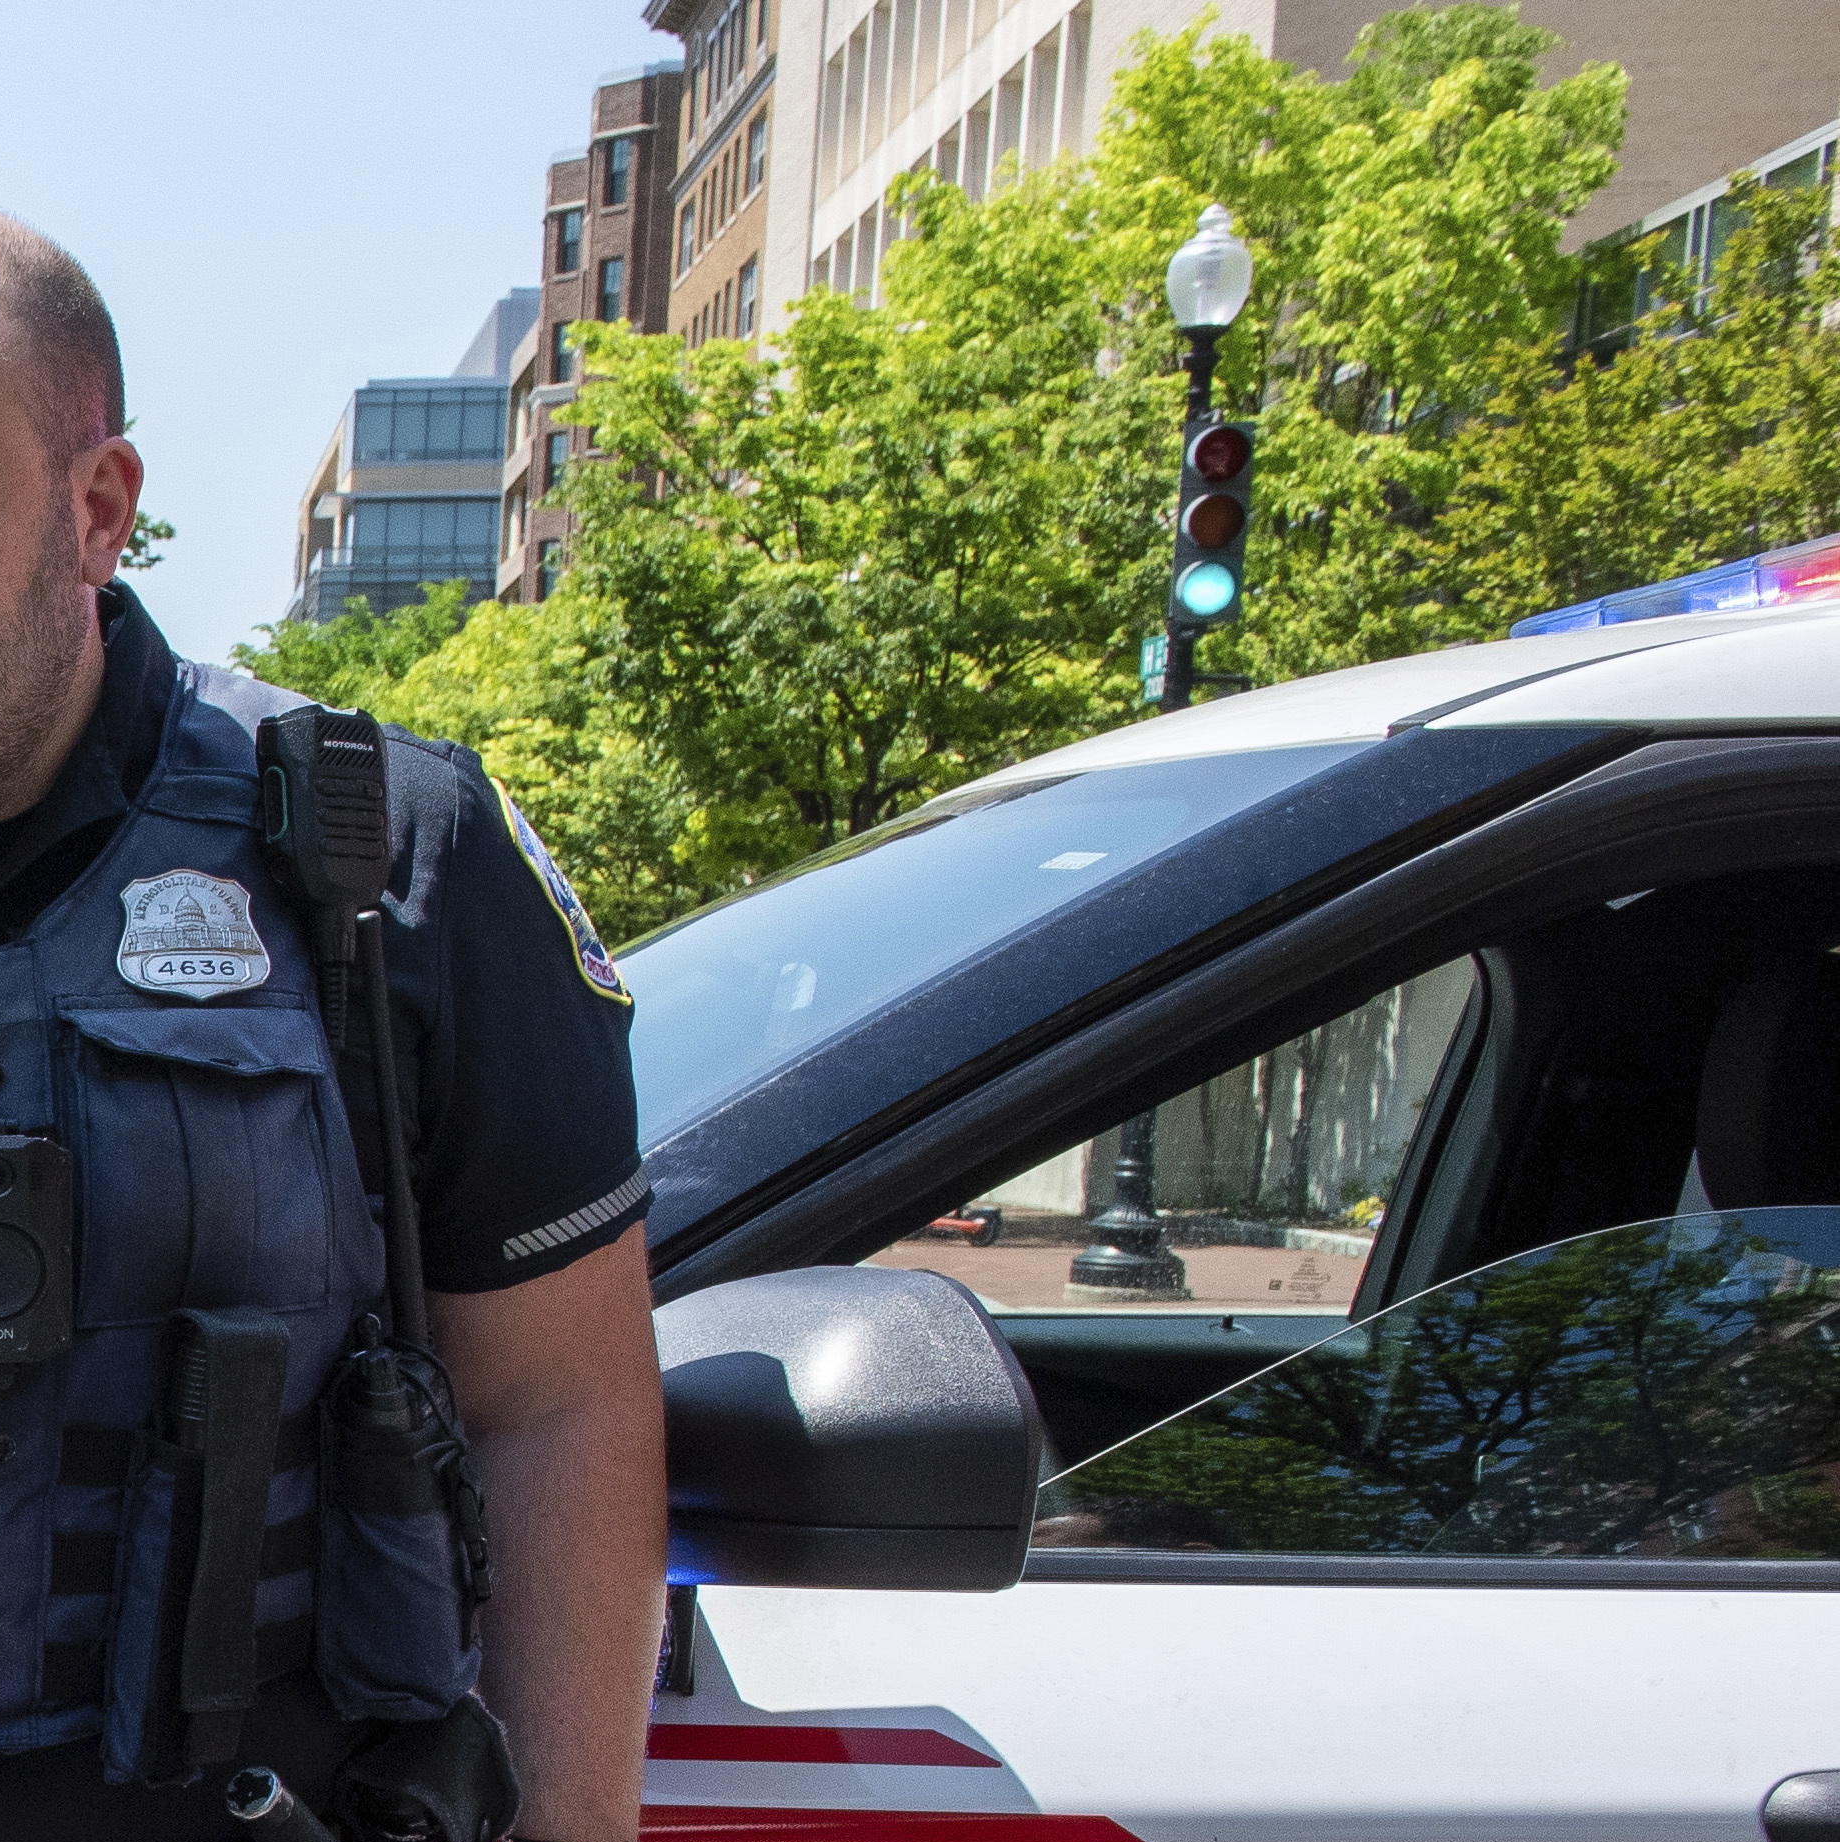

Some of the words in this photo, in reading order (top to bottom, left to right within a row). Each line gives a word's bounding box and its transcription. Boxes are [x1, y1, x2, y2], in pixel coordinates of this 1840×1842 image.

[323, 740, 374, 752] MOTOROLA
[133, 875, 208, 921] METROPOLITAN
[157, 960, 236, 976] 4636
